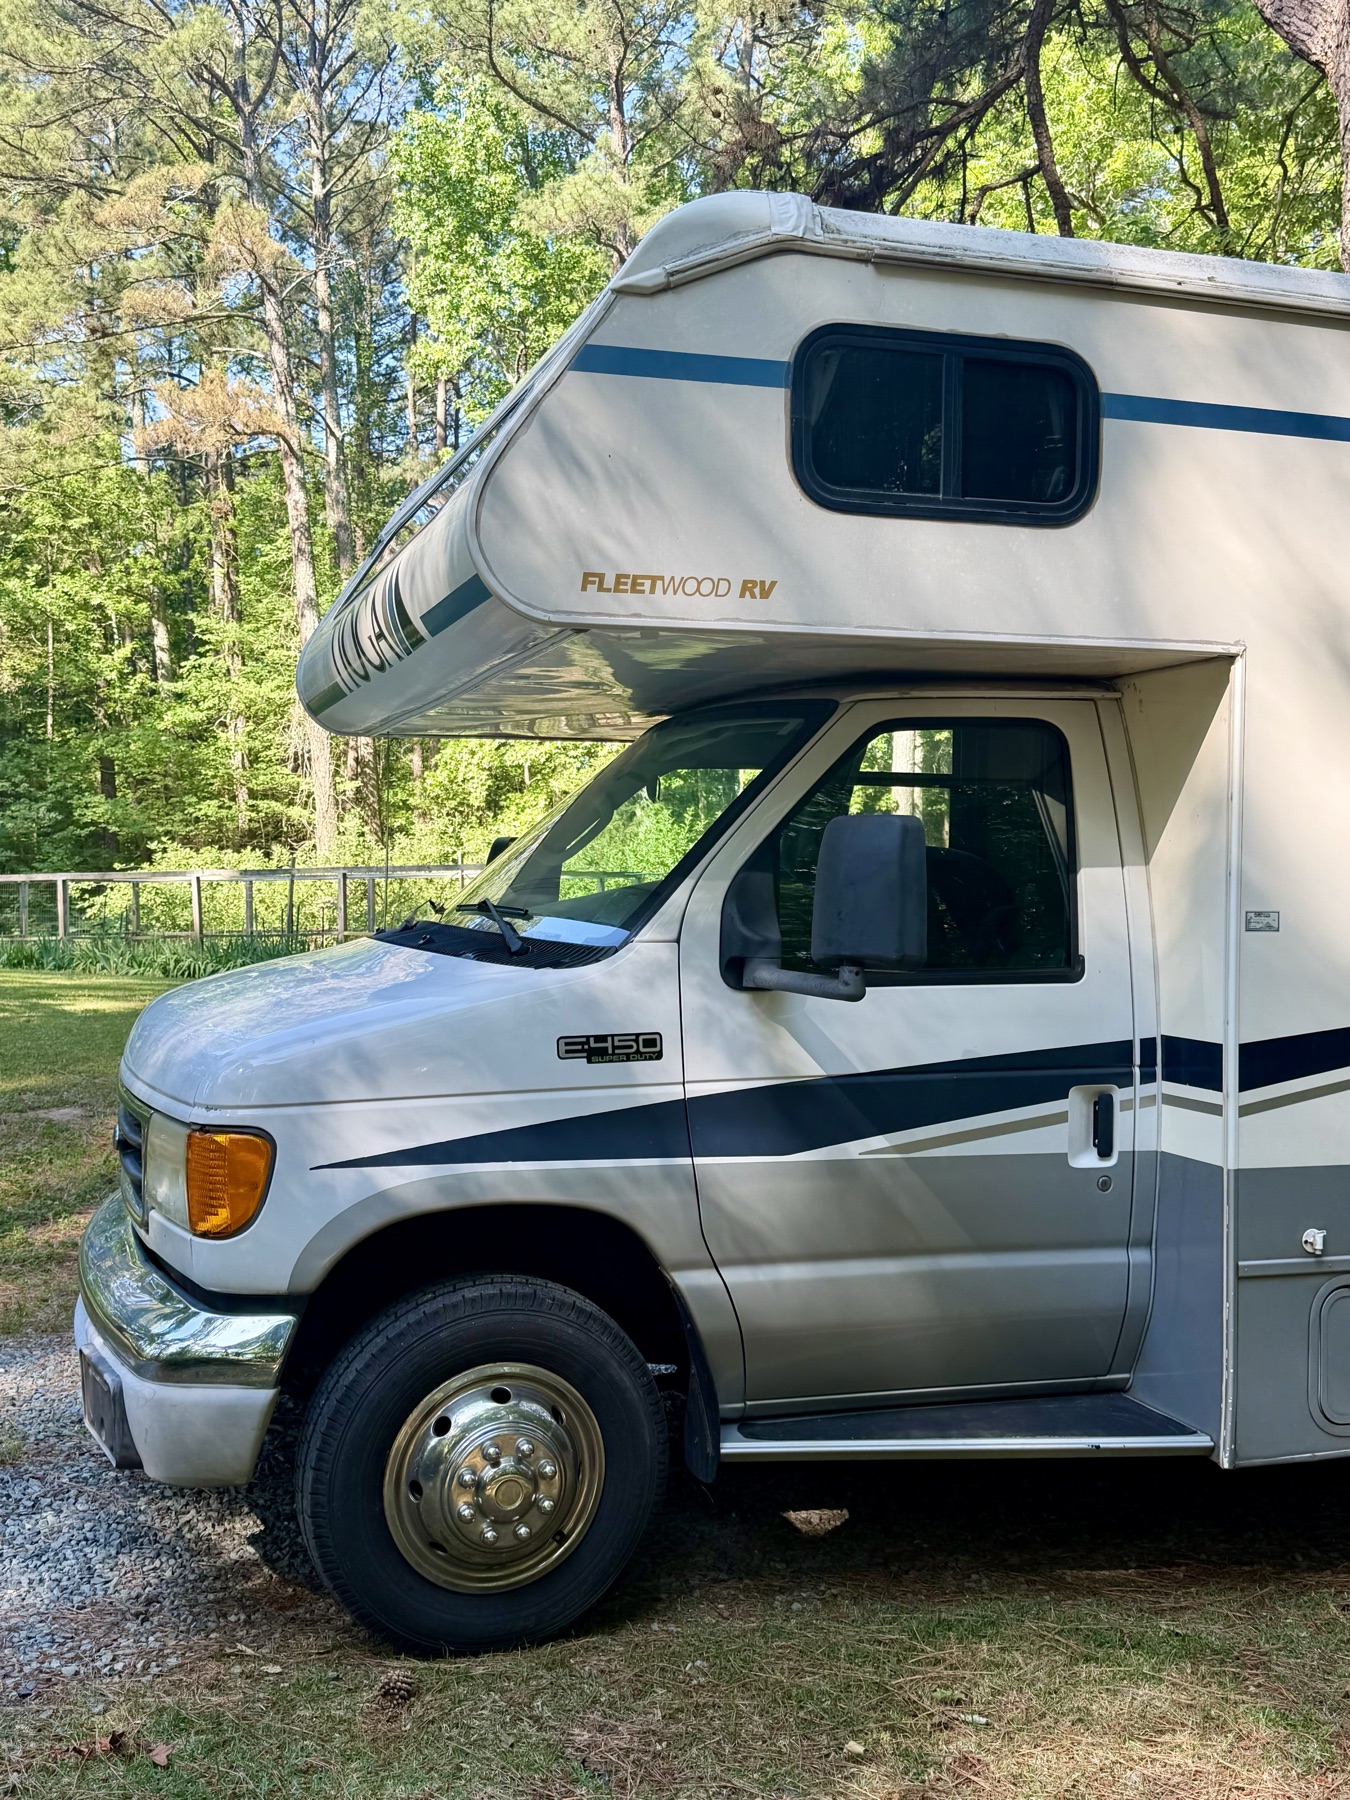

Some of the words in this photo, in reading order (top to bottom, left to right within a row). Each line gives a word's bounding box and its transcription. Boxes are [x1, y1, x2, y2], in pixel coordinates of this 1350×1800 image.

[580, 571, 732, 598] FLEETWOOD
[738, 579, 778, 599] RV
[591, 1054, 627, 1063] SUPER
